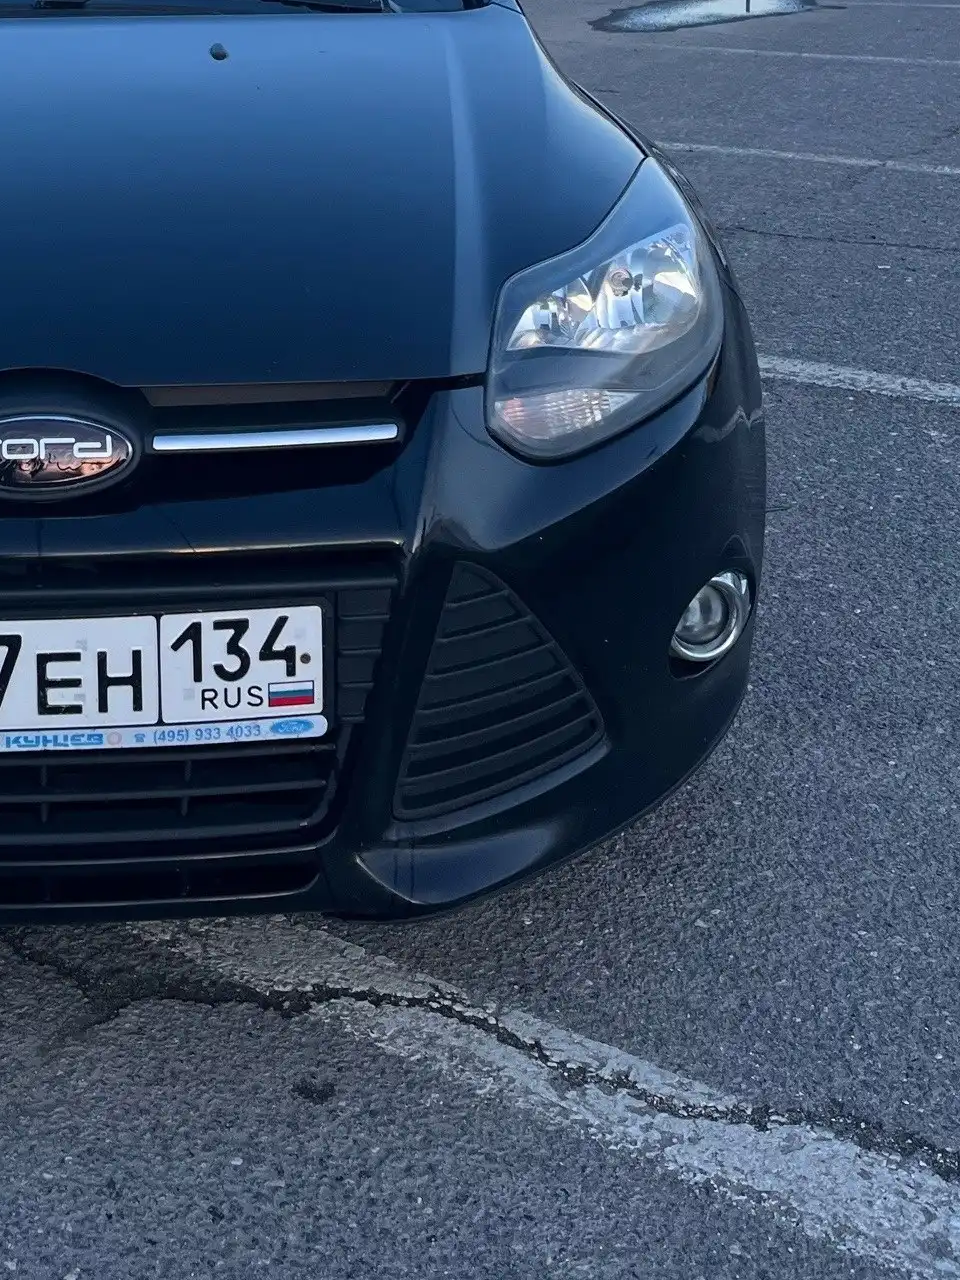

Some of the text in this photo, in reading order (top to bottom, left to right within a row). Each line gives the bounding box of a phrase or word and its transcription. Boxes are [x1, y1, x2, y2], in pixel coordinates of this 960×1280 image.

[170, 615, 297, 683] 134
[201, 685, 265, 711] RUS
[153, 728, 190, 745] (495)
[195, 727, 221, 741] 933
[226, 724, 262, 740] 4033
